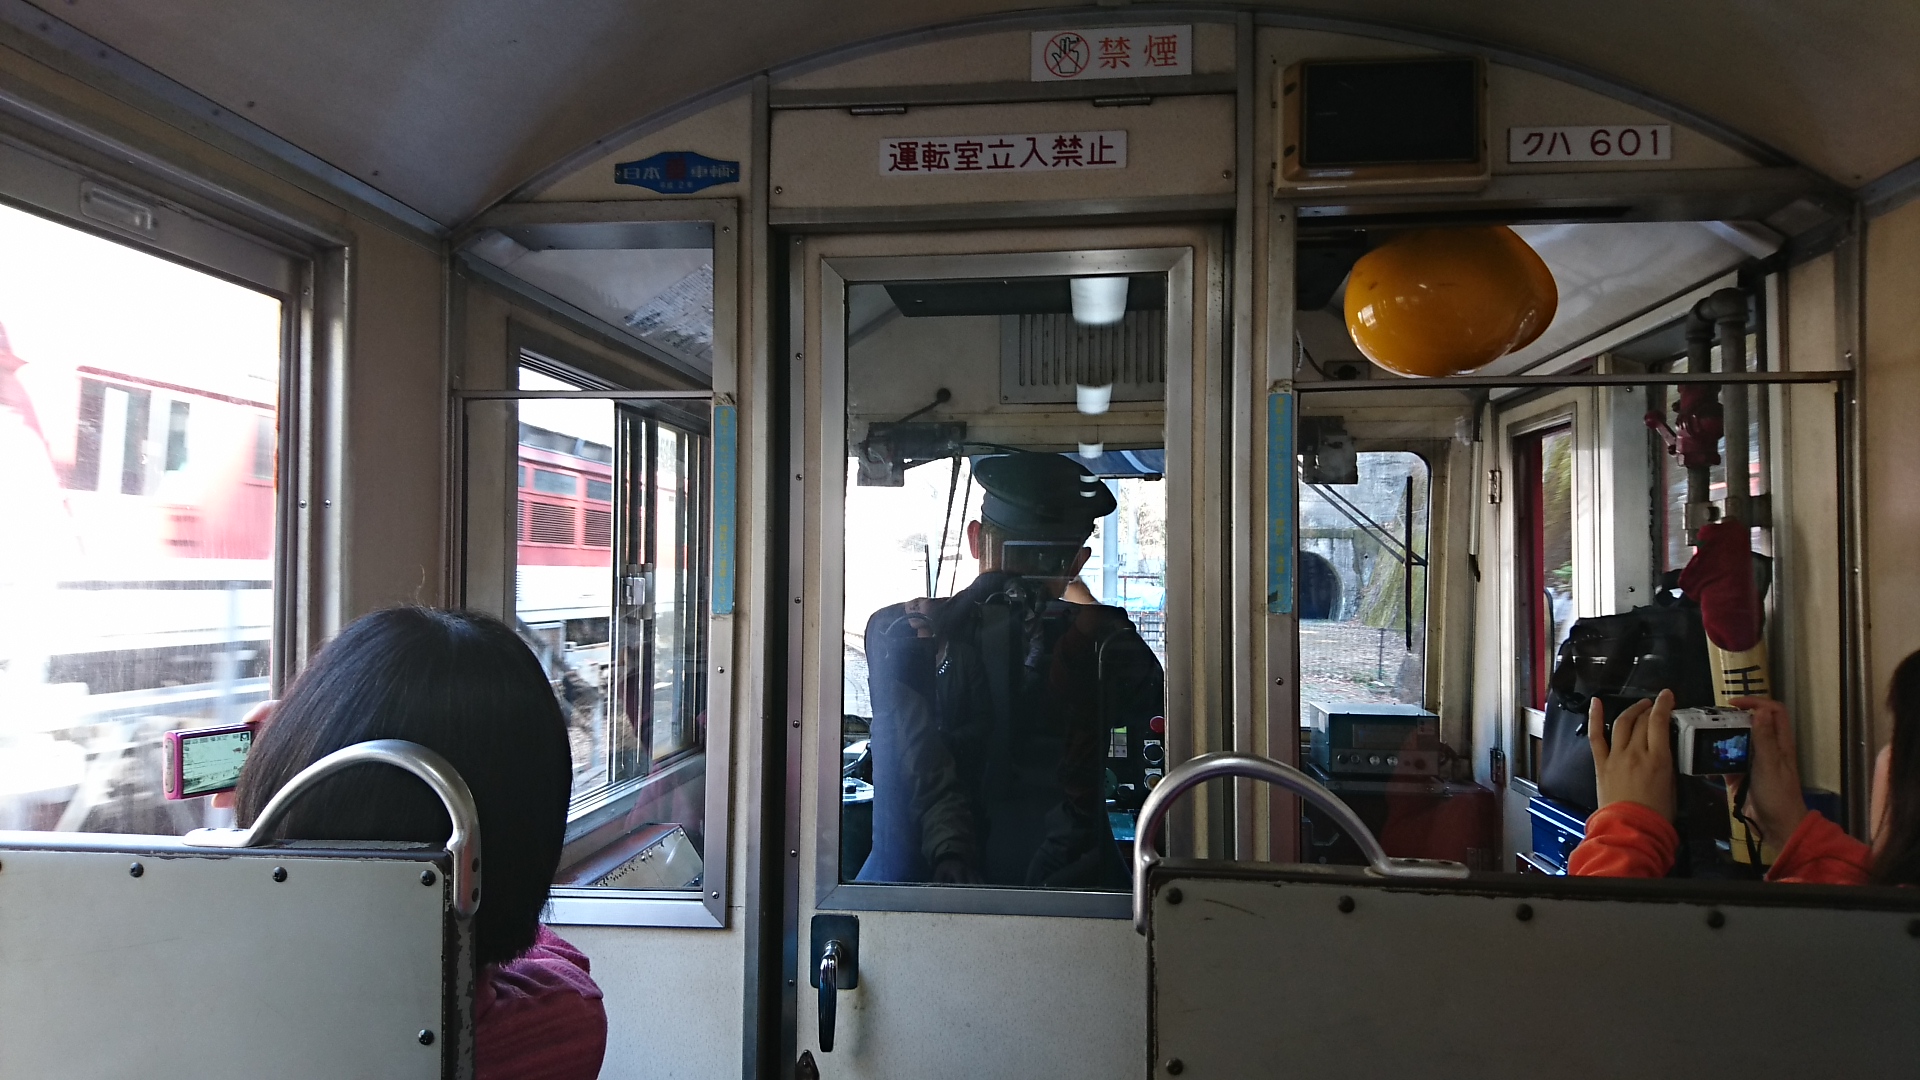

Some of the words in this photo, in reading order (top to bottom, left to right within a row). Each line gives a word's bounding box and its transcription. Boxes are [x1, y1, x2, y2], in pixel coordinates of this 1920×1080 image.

[1098, 34, 1179, 69] 禁煙
[888, 135, 1117, 172] 運転室立入禁止
[1523, 132, 1571, 156] クハ
[1590, 128, 1658, 156] 601
